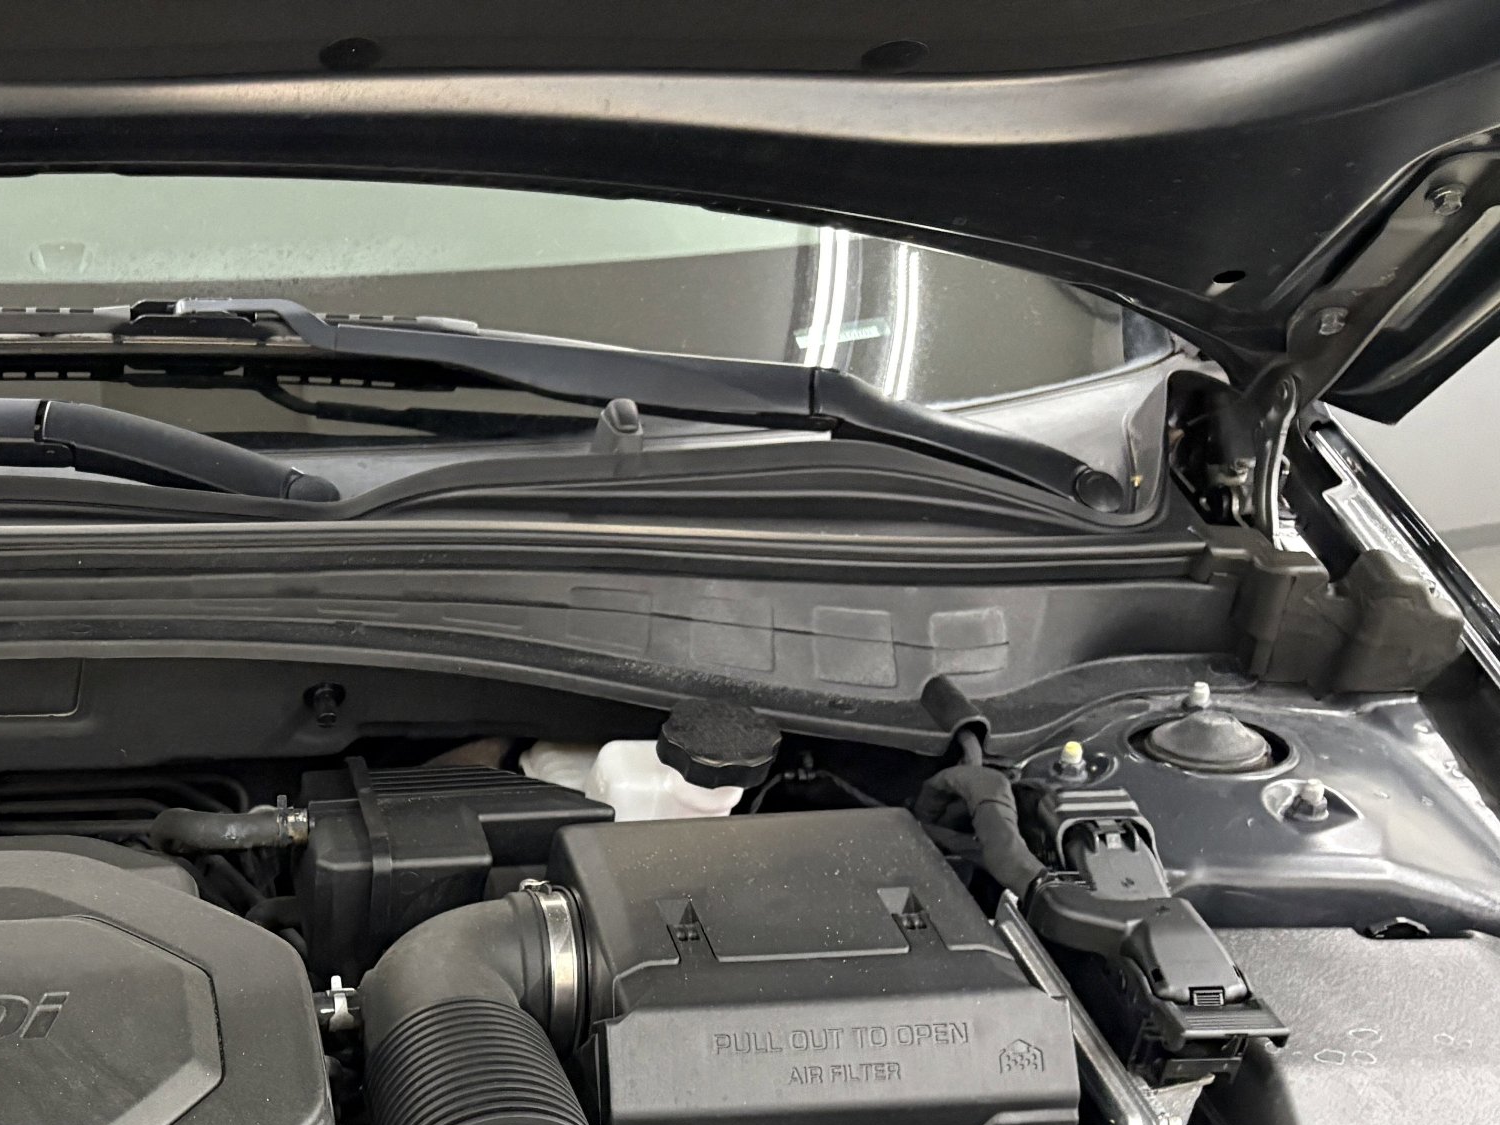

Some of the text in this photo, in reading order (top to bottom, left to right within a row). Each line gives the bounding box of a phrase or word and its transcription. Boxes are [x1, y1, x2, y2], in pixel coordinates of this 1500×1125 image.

[714, 1022, 969, 1054] PULL OUT TO OPEN
[788, 1062, 902, 1085] AIR FILTER
